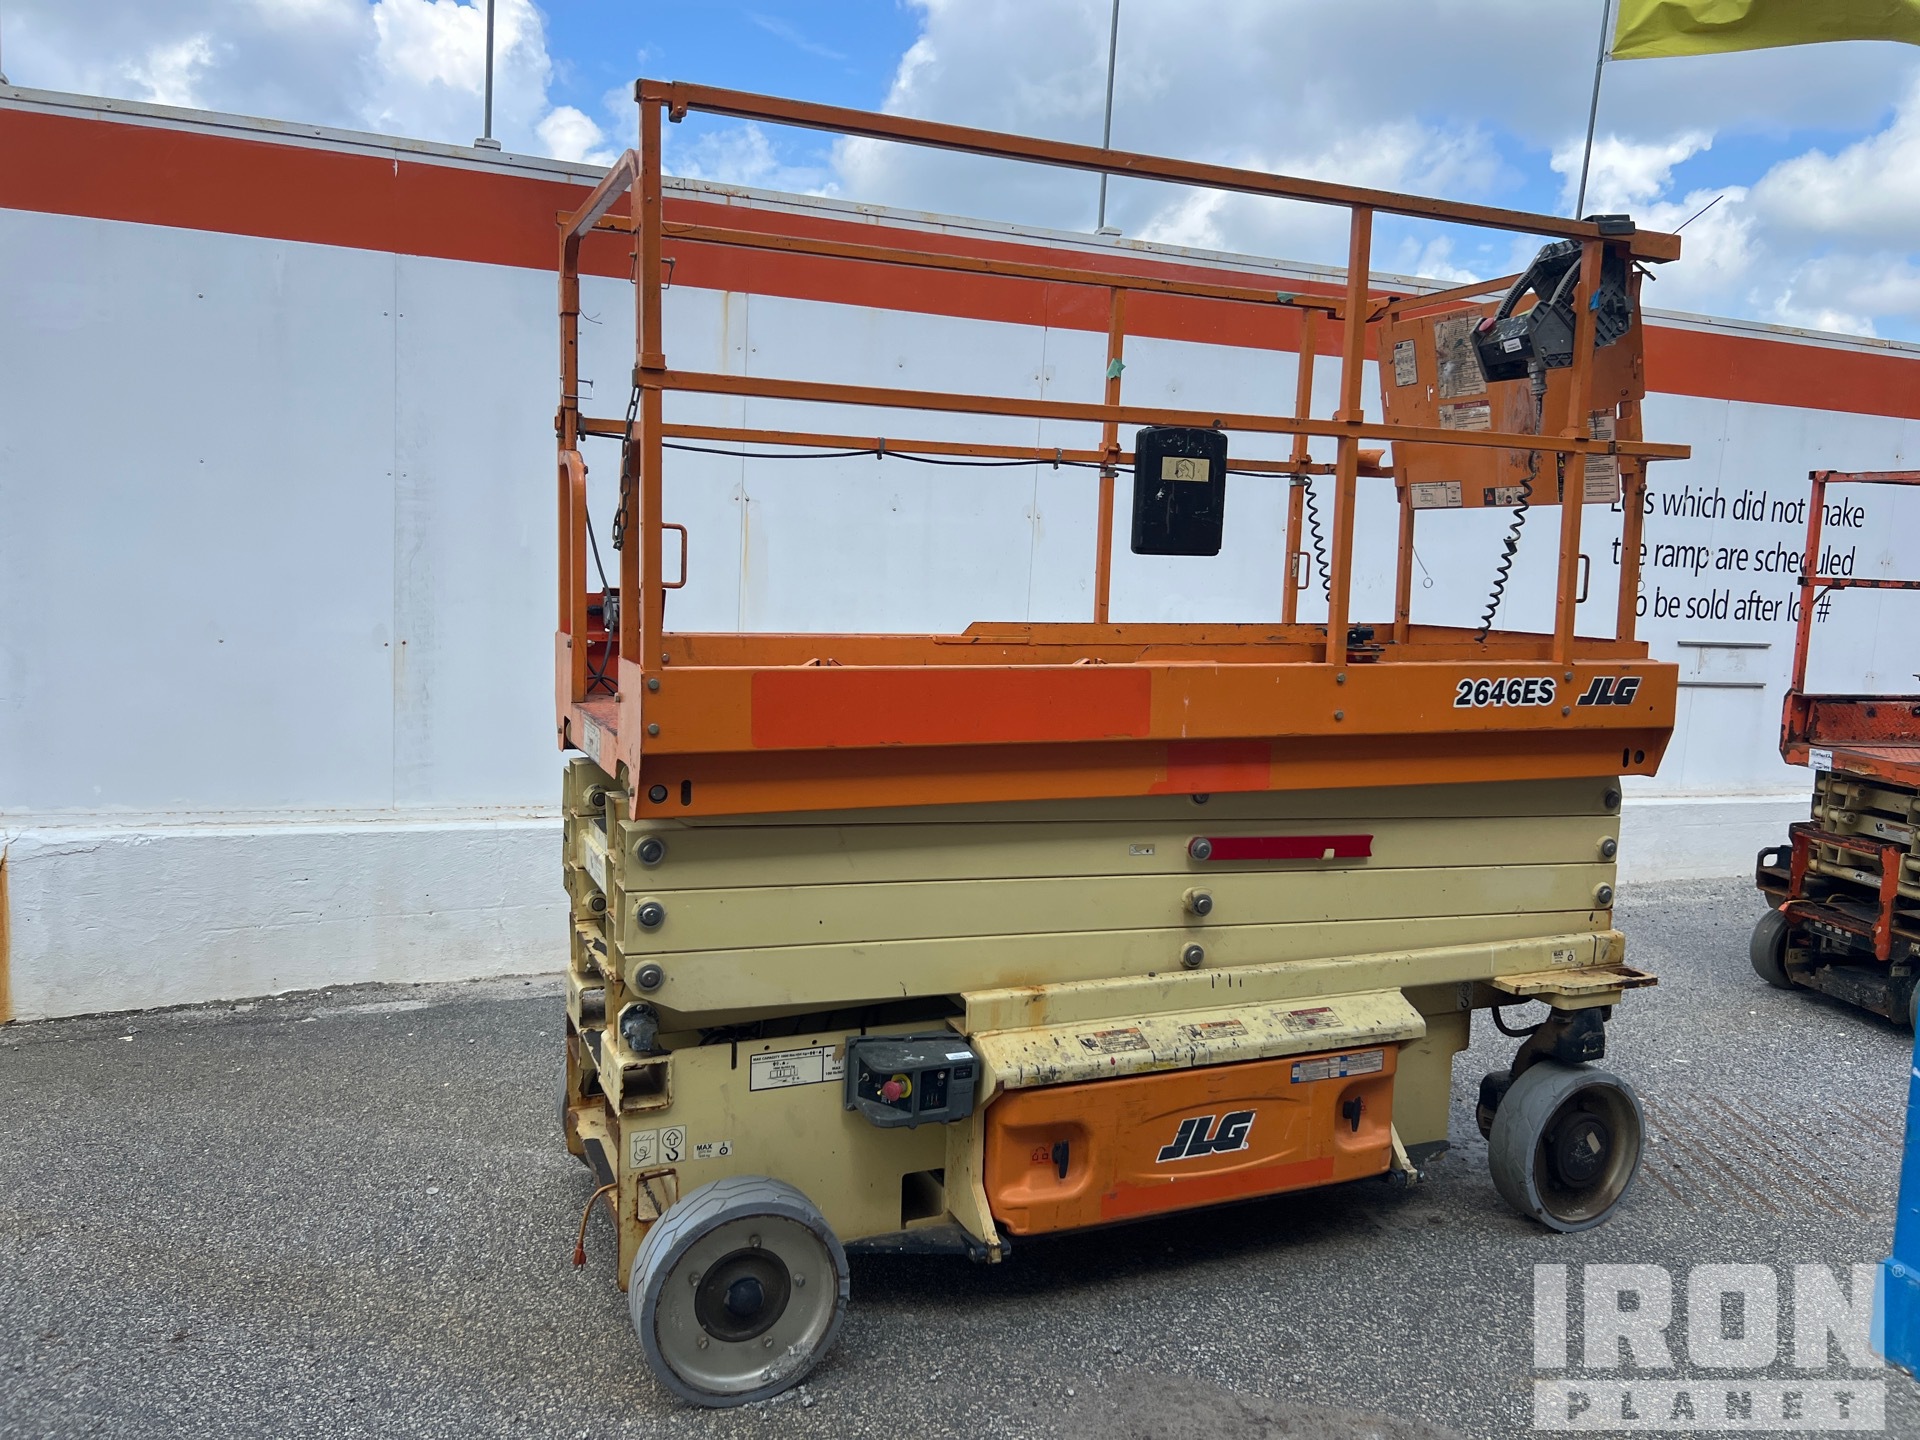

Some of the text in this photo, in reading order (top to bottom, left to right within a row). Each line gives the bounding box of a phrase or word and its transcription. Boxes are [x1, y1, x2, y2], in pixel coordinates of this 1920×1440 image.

[1662, 484, 1726, 519] which
[1732, 489, 1767, 522] did
[1771, 496, 1806, 525] not
[1611, 537, 1647, 565] te
[1653, 544, 1709, 577] ramp
[1715, 547, 1749, 571] are
[1653, 586, 1681, 619] be
[1685, 589, 1730, 620] sold
[1734, 589, 1782, 622] after
[1786, 592, 1802, 622] lo
[1816, 595, 1832, 623] #
[1453, 677, 1557, 707] 2646ES
[1576, 676, 1642, 706] JLG
[696, 1143, 712, 1151] MAX
[1156, 1108, 1257, 1163] JLG
